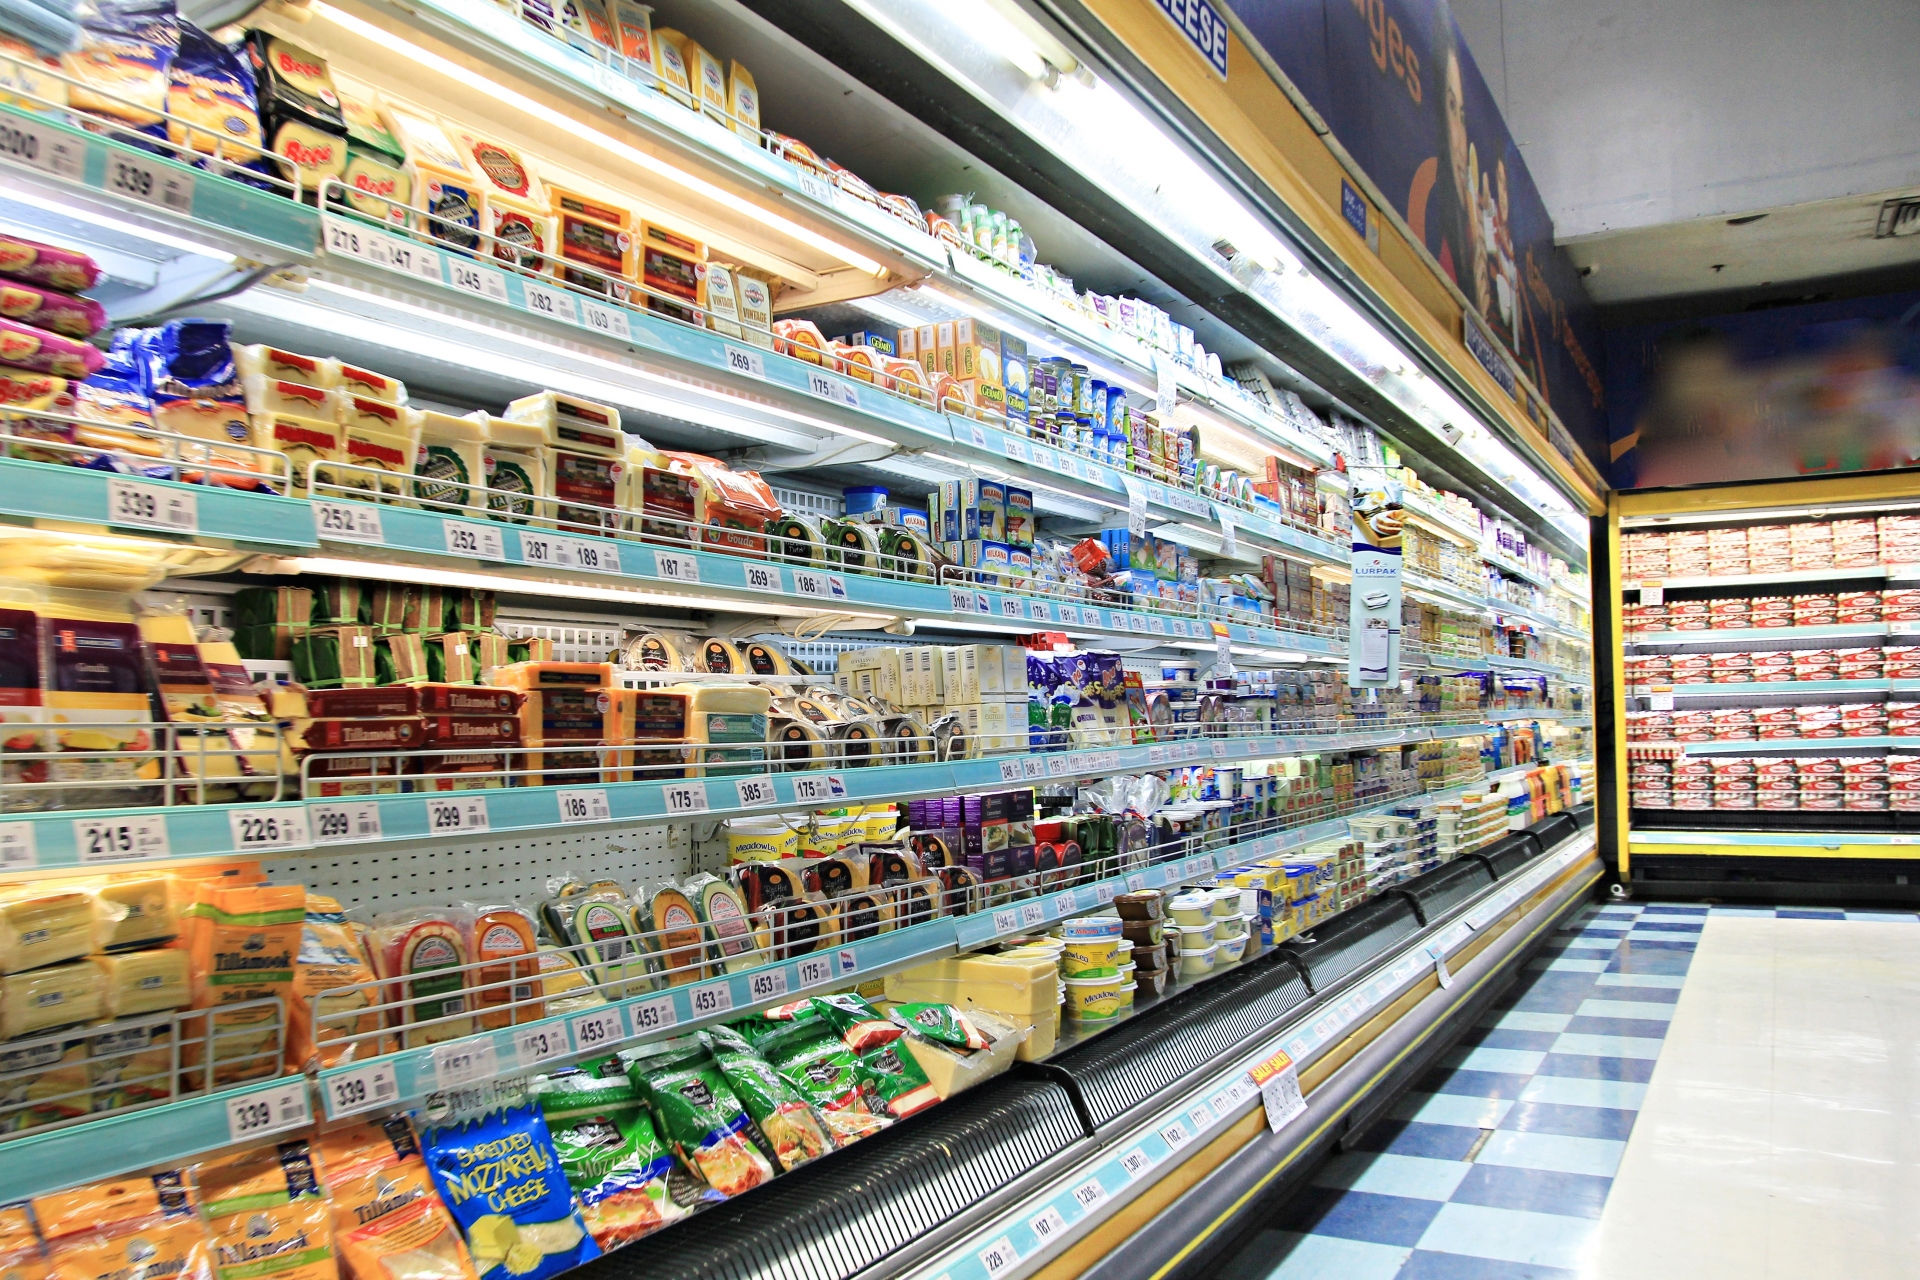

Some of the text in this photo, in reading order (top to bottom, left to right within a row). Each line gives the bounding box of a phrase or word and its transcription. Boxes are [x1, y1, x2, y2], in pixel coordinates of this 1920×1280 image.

[1352, 0, 1422, 105] ges
[455, 268, 481, 291] 245
[529, 289, 554, 313] 282
[712, 293, 735, 310] VINTAGE
[742, 307, 768, 324] VINTAGE
[730, 349, 751, 371] 269
[812, 376, 830, 396] 175
[983, 488, 1003, 500] MILKANA
[1010, 494, 1031, 507] MILKANA
[320, 505, 355, 532] 252
[905, 516, 926, 529] MILKANA
[450, 529, 478, 551] 252
[727, 533, 755, 549] Gouda
[525, 539, 549, 562] 287
[576, 546, 599, 567] 189
[986, 549, 1007, 562] MILKANA
[1011, 554, 1031, 566] MILKANA
[660, 558, 678, 577] 187
[749, 568, 768, 587] 269
[799, 575, 816, 593] 186
[953, 595, 965, 609] 310
[1003, 600, 1015, 614] 175
[1032, 605, 1043, 618] 178
[450, 693, 496, 709] Tillamook
[343, 726, 397, 742] Tillamook
[452, 722, 499, 737] Tillamook
[741, 780, 762, 803] 385
[798, 780, 816, 798] 175
[564, 798, 587, 817] 186
[669, 789, 692, 810] 175
[318, 812, 349, 838] 299
[433, 805, 461, 829] 299
[86, 825, 133, 854] 215
[241, 817, 279, 843] 226
[735, 842, 778, 854] MeadowLea
[995, 914, 1009, 928] 194
[1024, 906, 1036, 922] 194
[214, 950, 293, 972] Tillamook
[801, 962, 819, 982] 175
[754, 975, 774, 995] 453
[695, 989, 717, 1011] 453
[636, 1006, 660, 1028] 453
[579, 1020, 606, 1043] 453
[456, 1132, 532, 1168] SHREDDED
[446, 1142, 551, 1206] MOZZARELLA
[487, 1177, 551, 1214] CHEESE
[1035, 1219, 1052, 1237] 187
[985, 1250, 1004, 1272] 229
